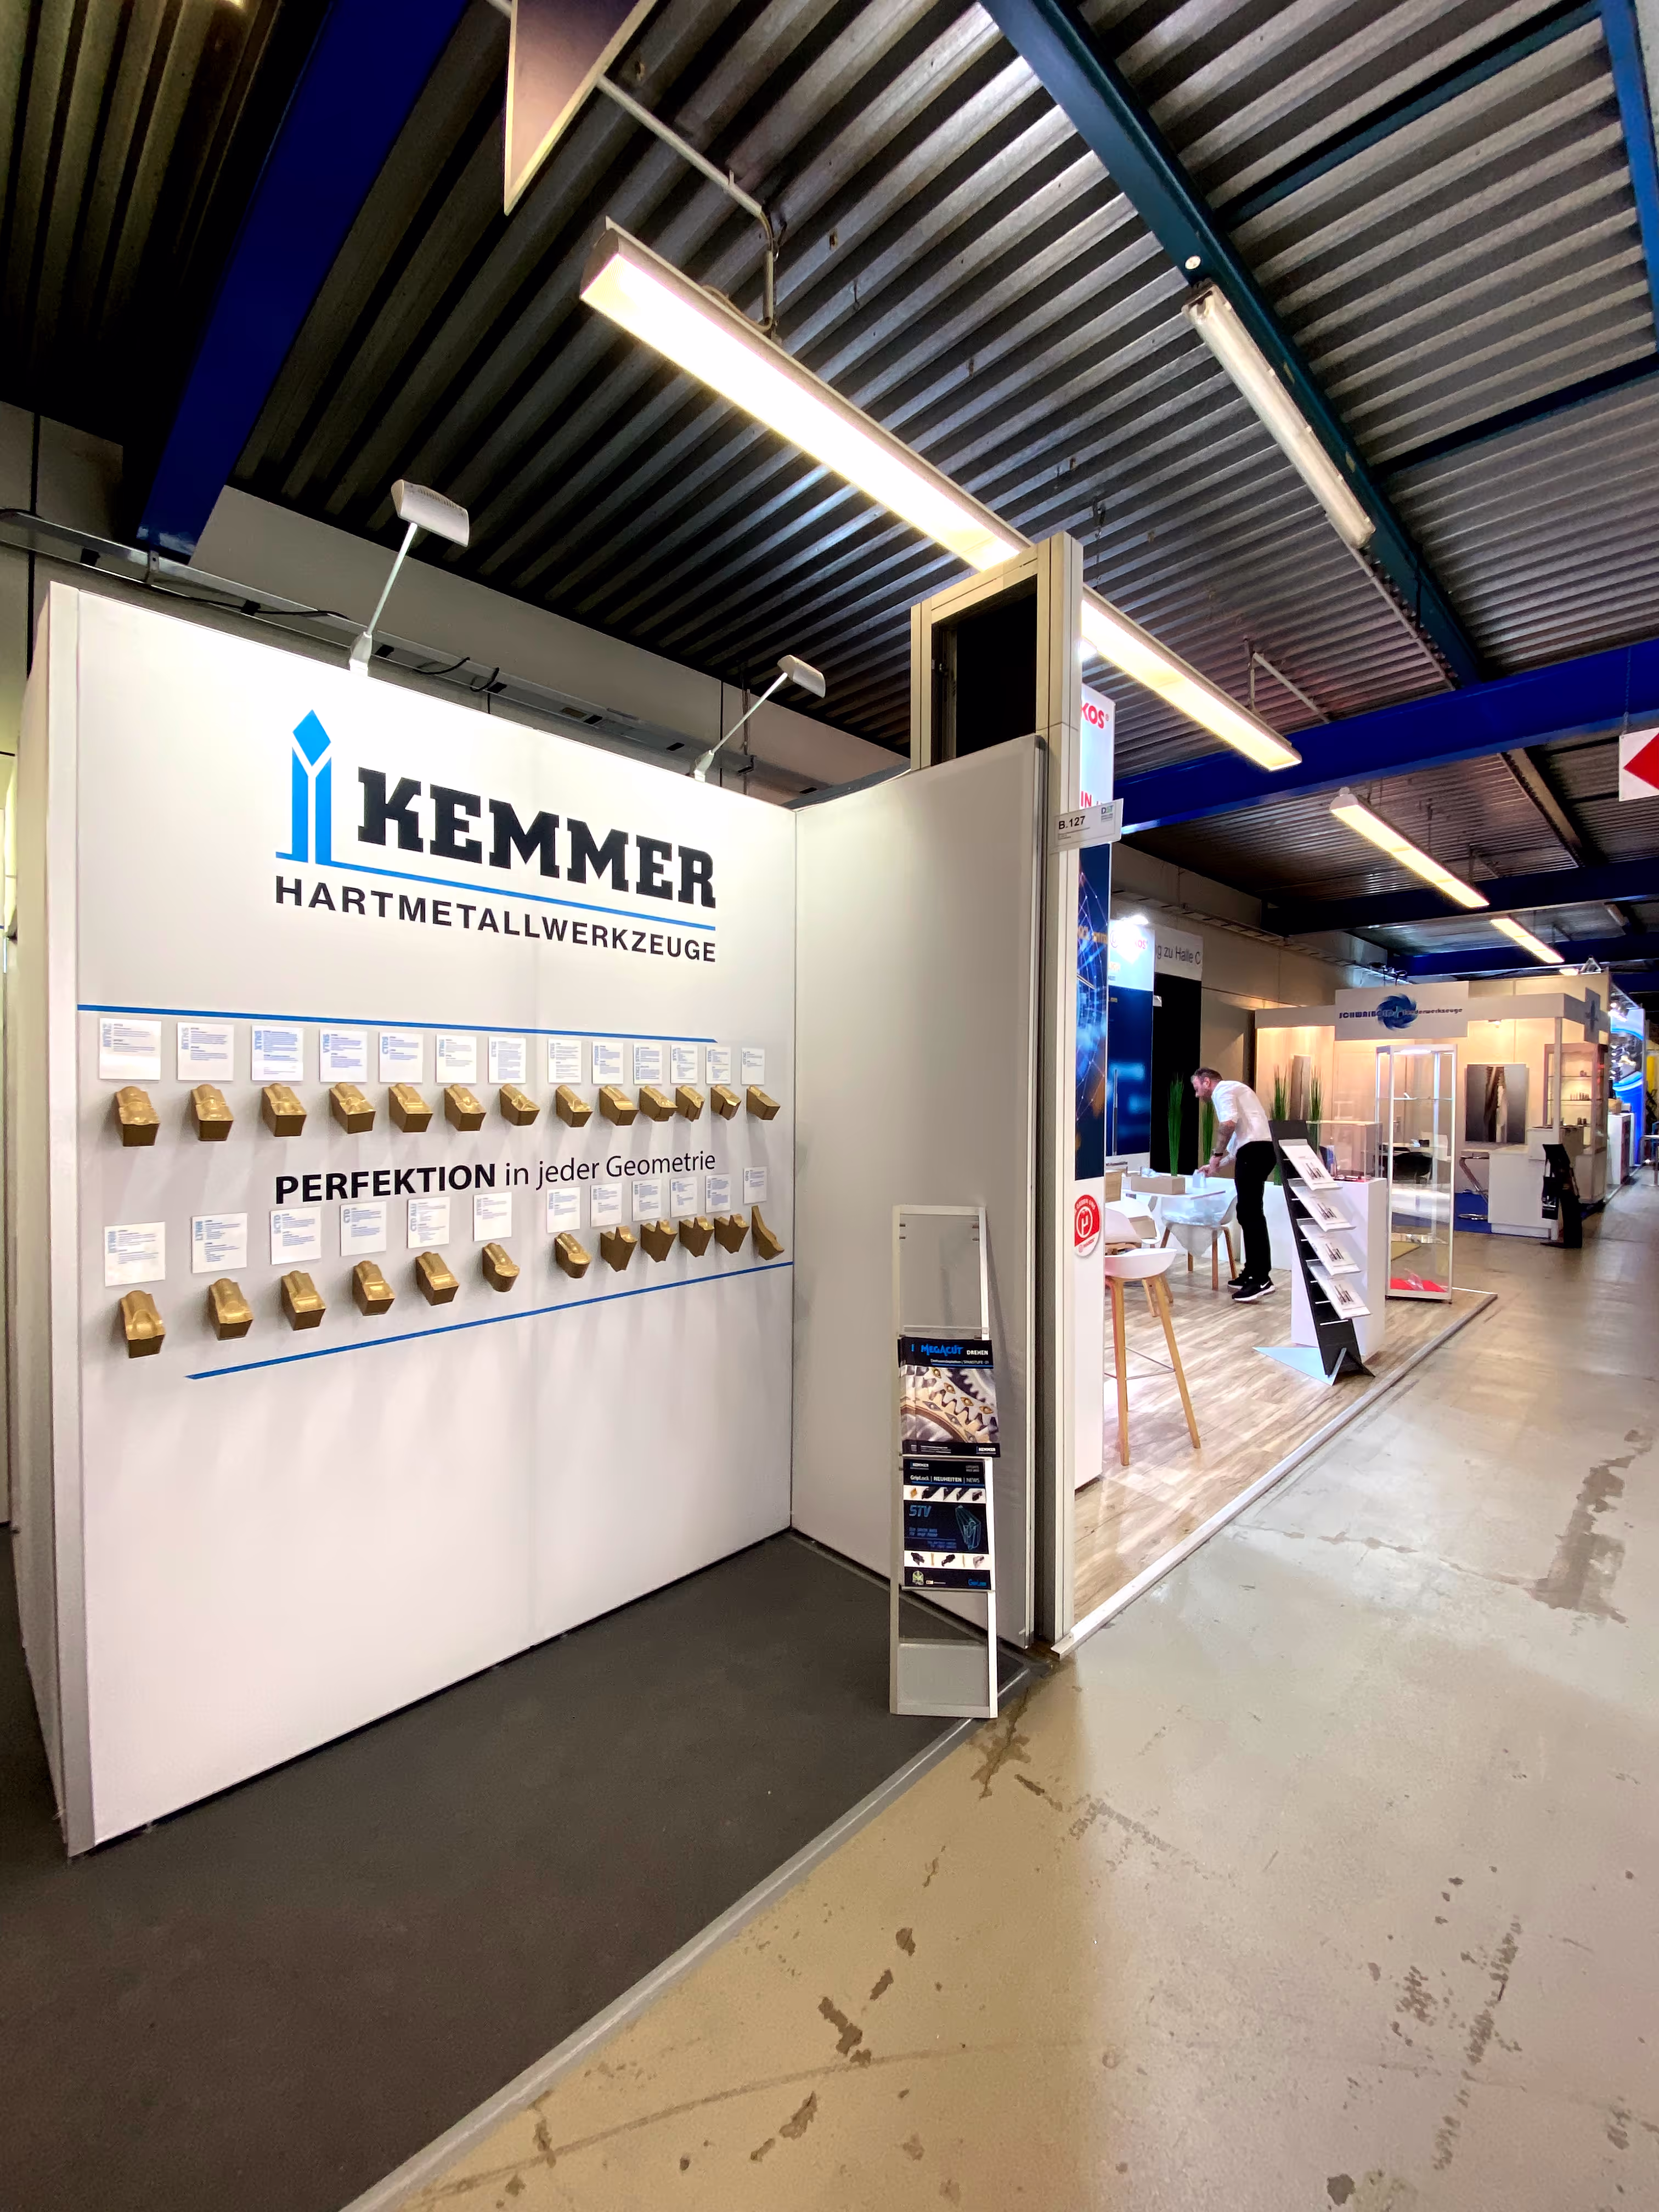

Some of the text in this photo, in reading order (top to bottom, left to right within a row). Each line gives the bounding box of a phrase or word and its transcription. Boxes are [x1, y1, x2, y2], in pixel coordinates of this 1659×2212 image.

[1058, 816, 1086, 830] B.127
[358, 766, 715, 909] KEMMER
[276, 876, 716, 962] HARTMETALLWERKZEUGE
[1164, 947, 1173, 959] zu
[1175, 945, 1194, 963] Halle
[1195, 951, 1201, 965] C
[276, 1150, 715, 1204] PERFEKTION in jeder Geometrie
[921, 1344, 964, 1357] MEGACUT
[909, 1504, 932, 1517] STV
